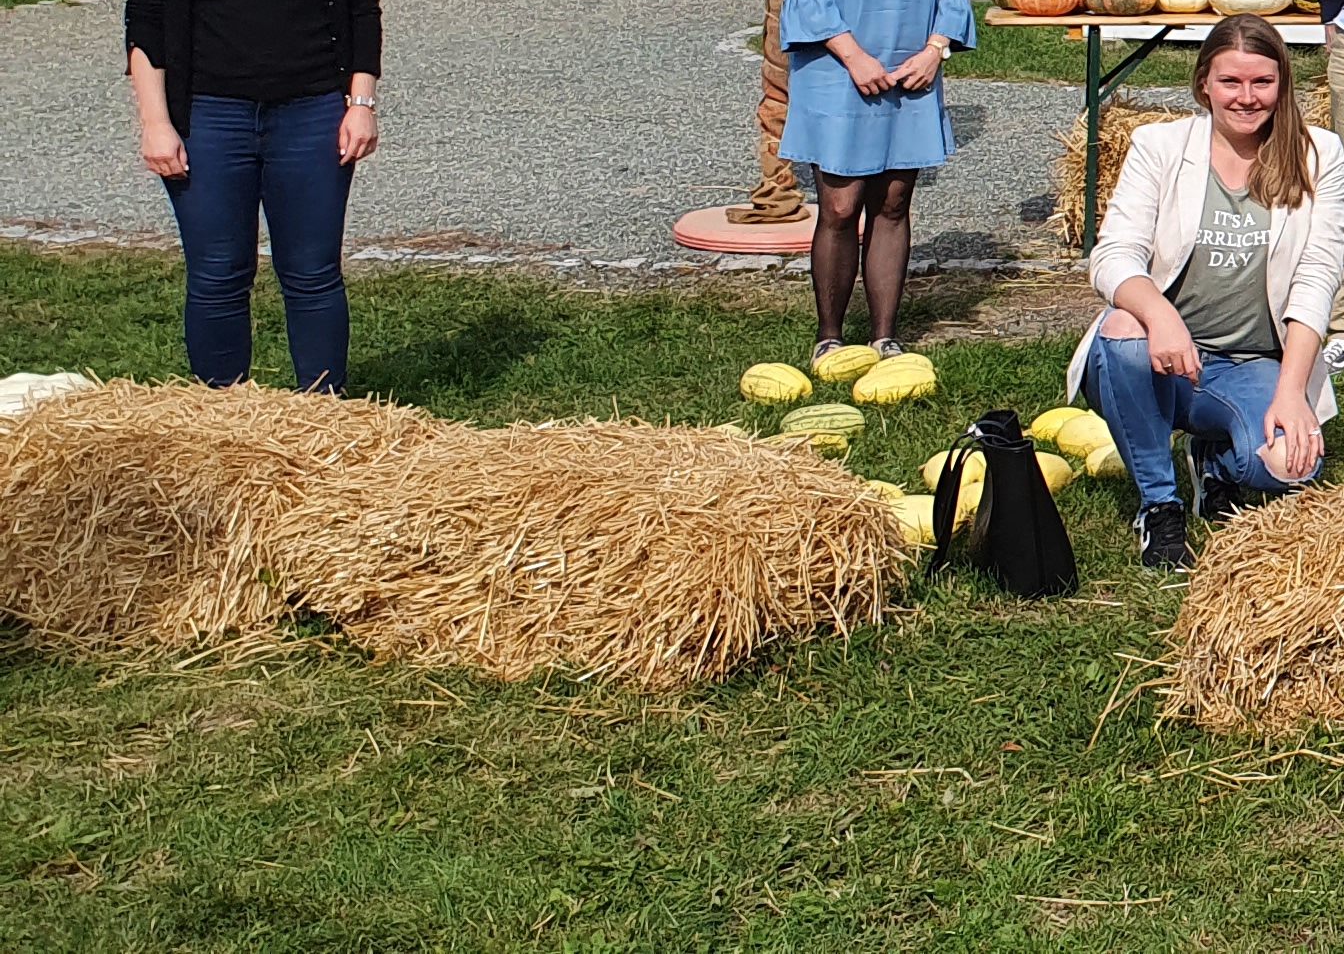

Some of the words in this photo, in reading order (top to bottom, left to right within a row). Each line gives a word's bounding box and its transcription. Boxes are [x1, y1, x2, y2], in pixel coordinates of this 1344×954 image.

[1213, 210, 1241, 228] IT'S
[1243, 212, 1256, 227] A
[1208, 251, 1253, 268] DAY
